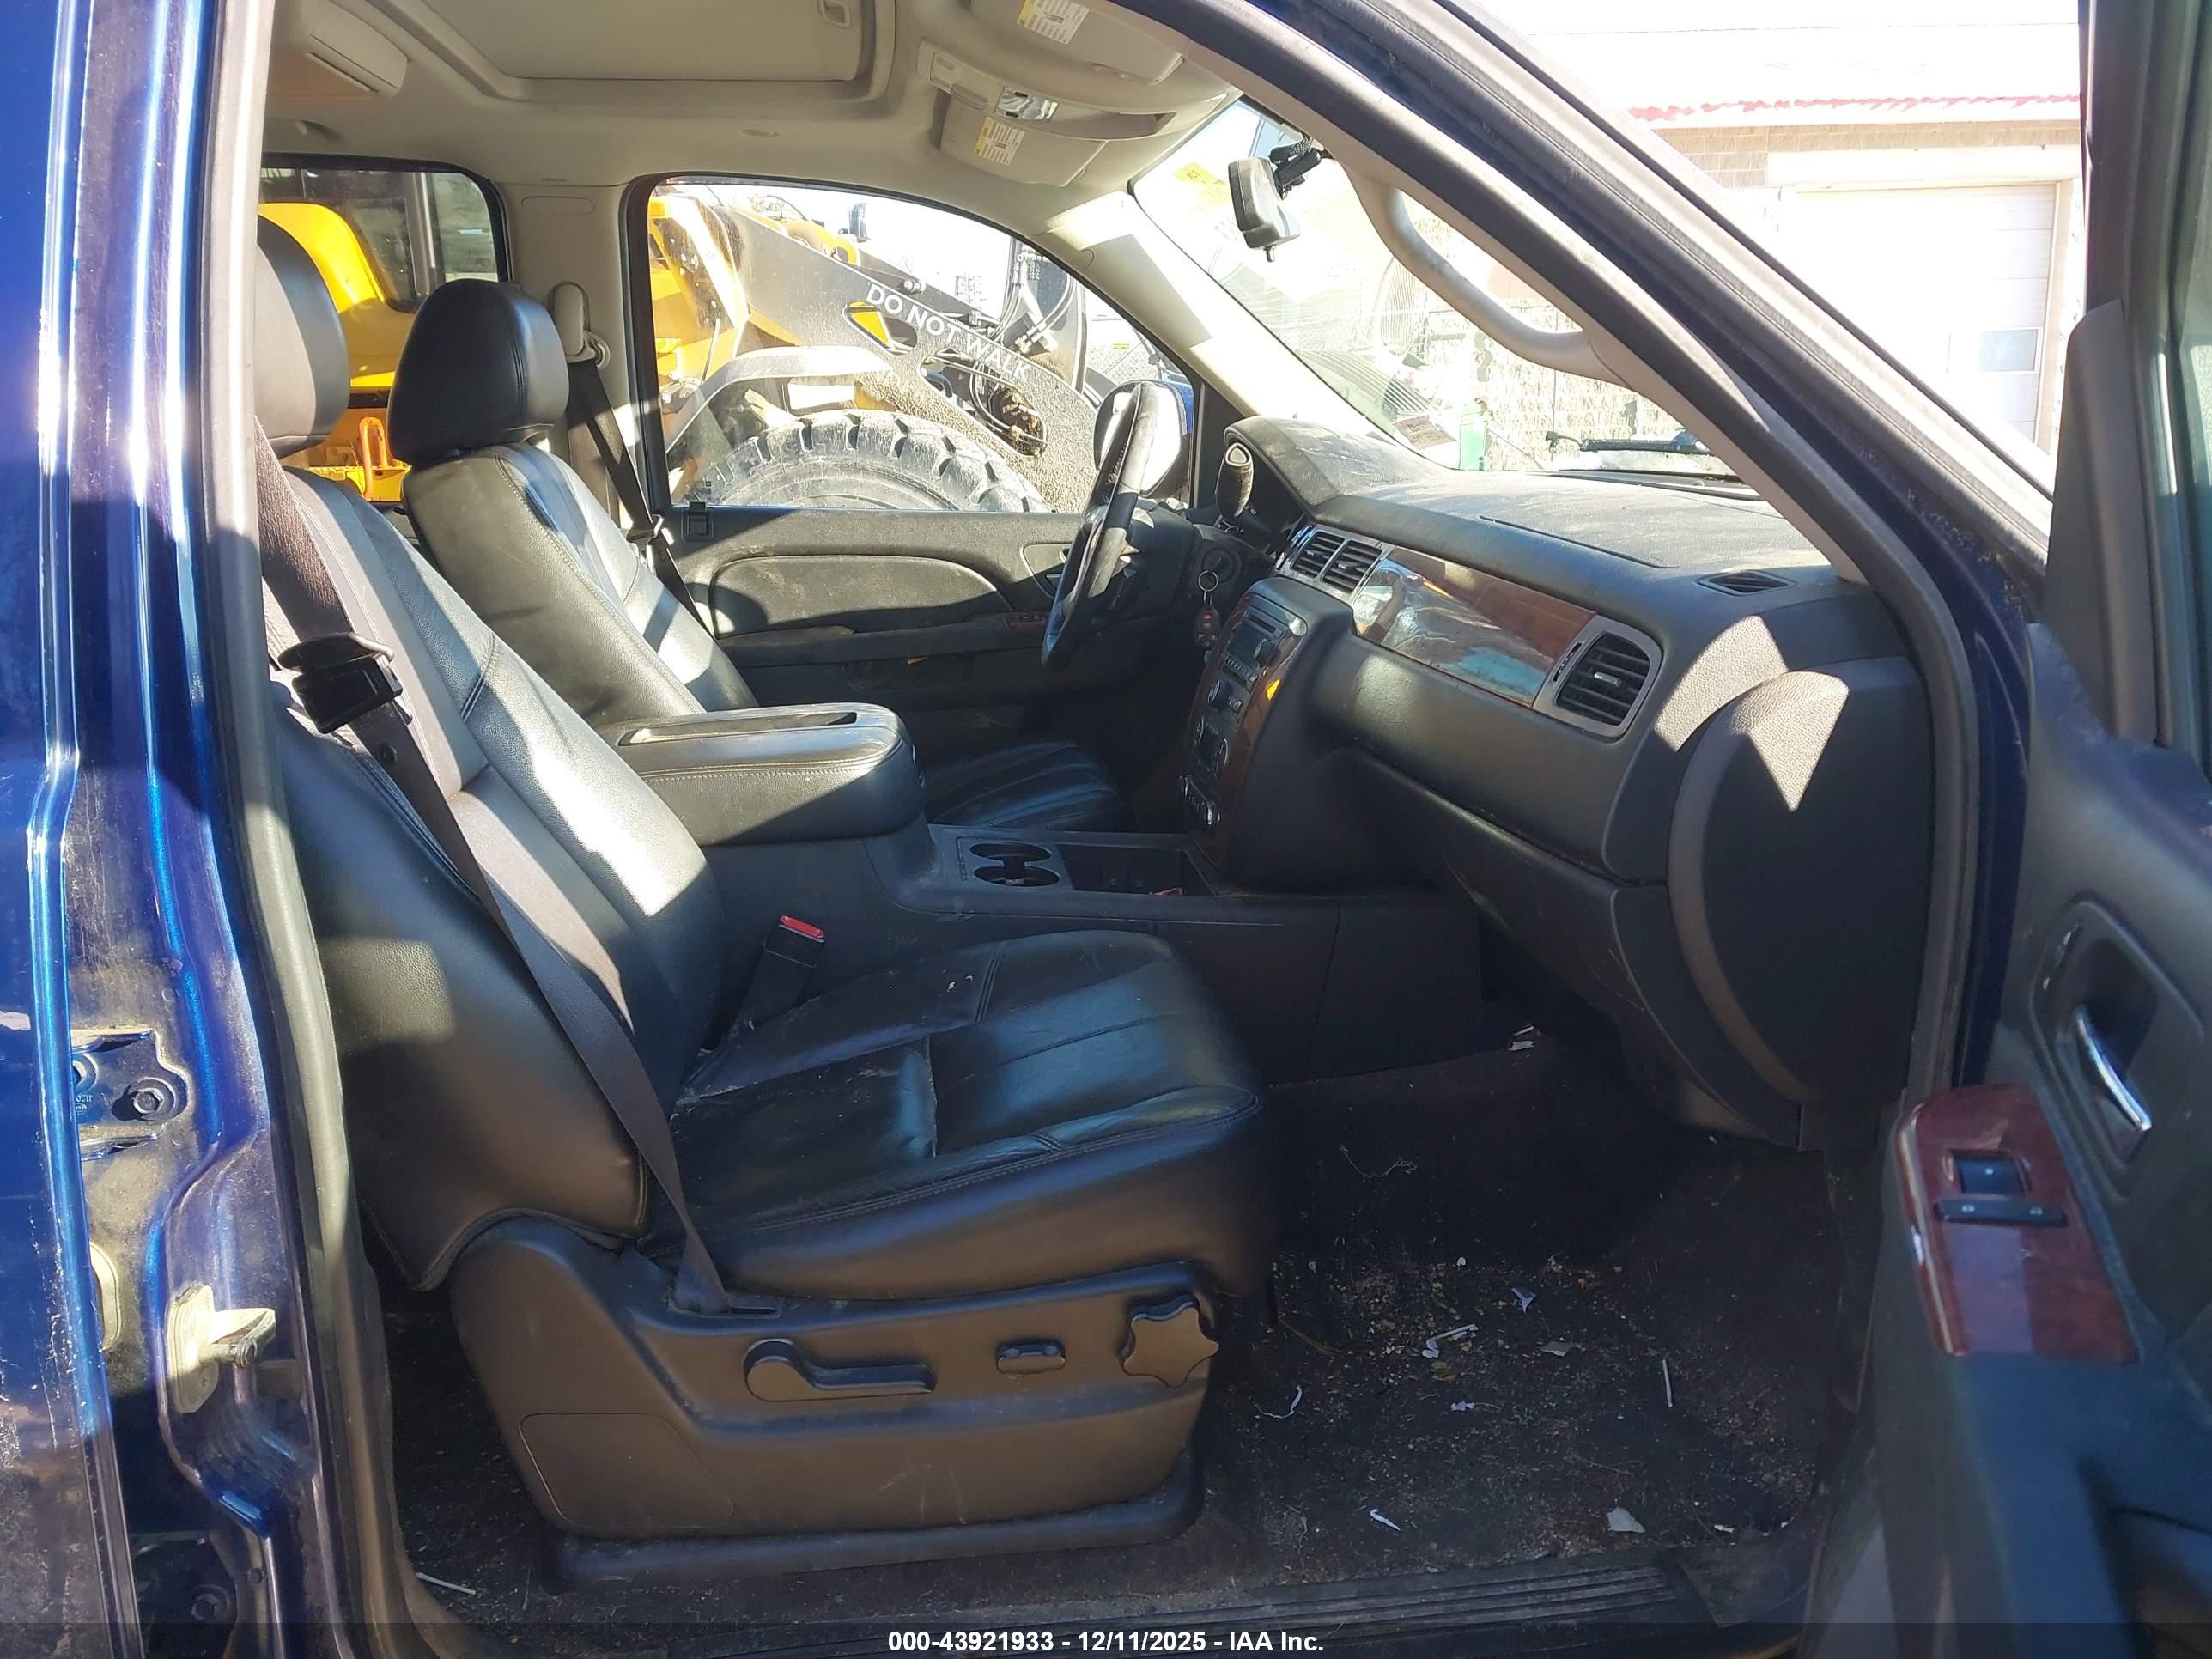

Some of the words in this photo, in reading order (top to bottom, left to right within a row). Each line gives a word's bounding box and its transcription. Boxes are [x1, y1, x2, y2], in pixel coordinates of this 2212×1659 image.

[866, 285, 903, 314] DO
[907, 306, 962, 343] NOT
[964, 335, 1031, 380] WALK
